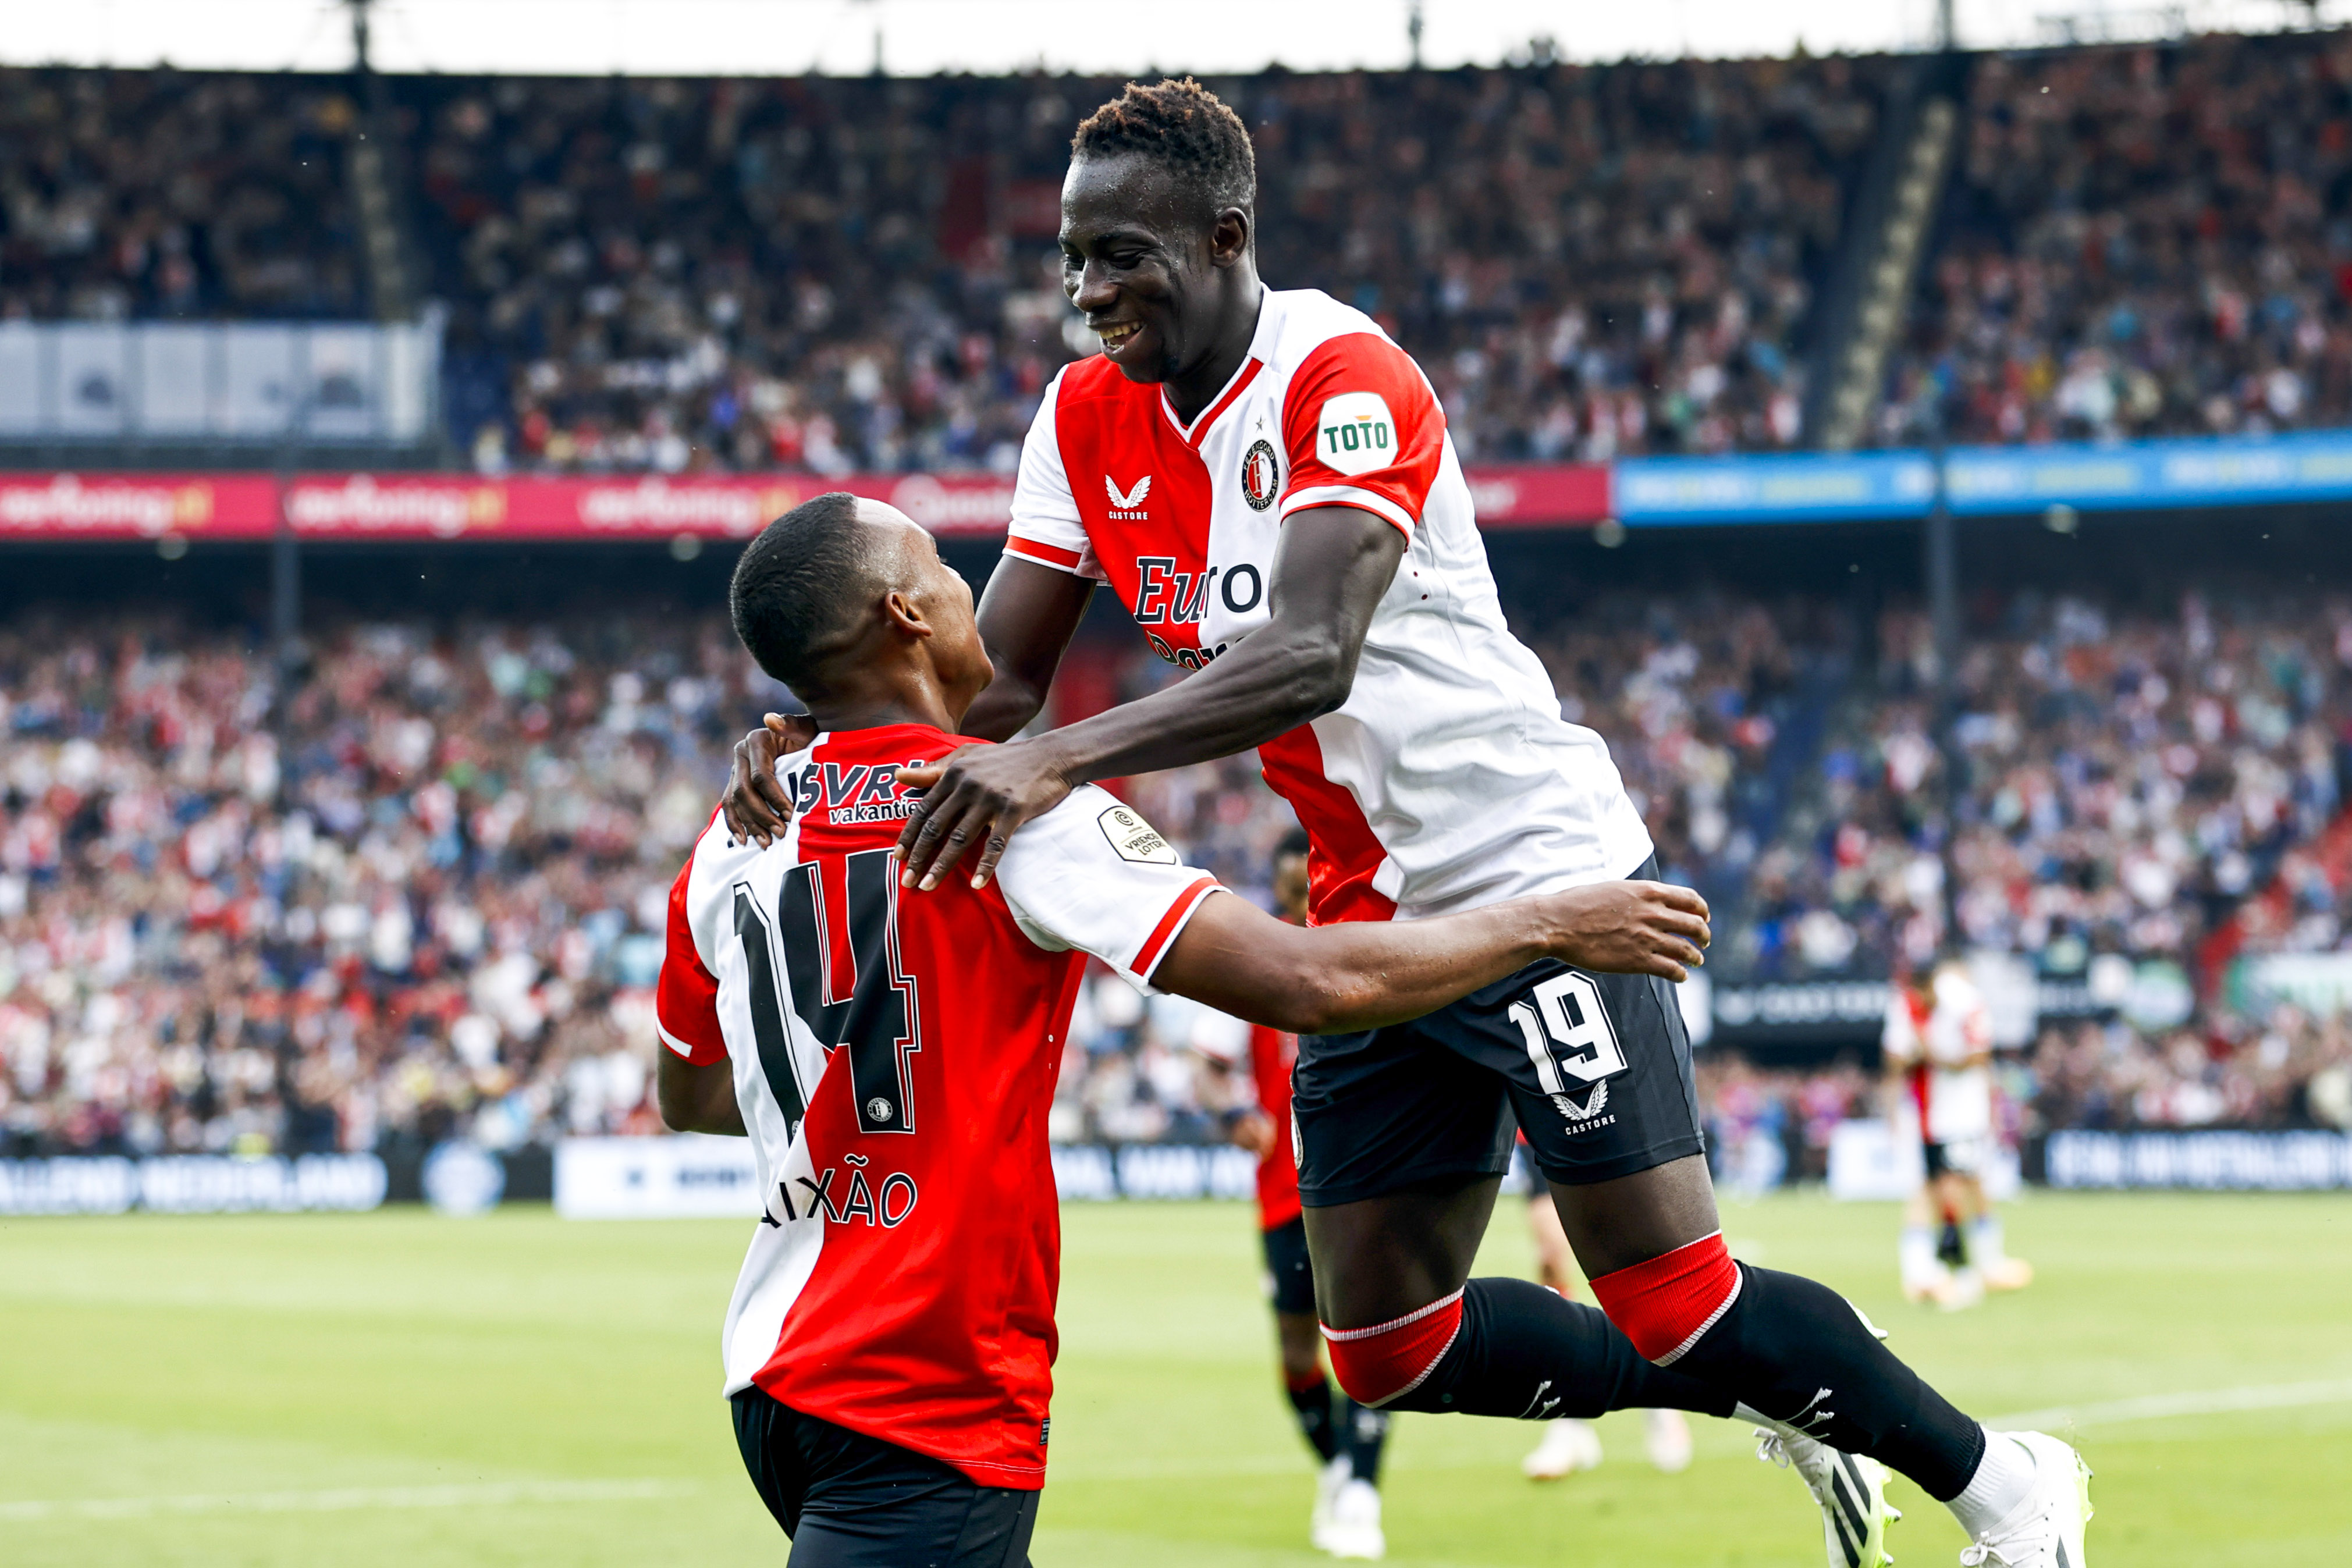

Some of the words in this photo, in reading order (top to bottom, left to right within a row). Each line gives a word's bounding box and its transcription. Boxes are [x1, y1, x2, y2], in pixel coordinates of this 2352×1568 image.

[1324, 422, 1388, 454] TOTO
[1243, 441, 1275, 470] FEYENOORD
[1244, 478, 1278, 510] ROTTERDAM
[1109, 511, 1148, 520] CASTORE
[1134, 556, 1262, 625] Euro
[733, 847, 922, 1147] 14
[1508, 970, 1628, 1094] 19
[1565, 1114, 1616, 1135] CASTORE
